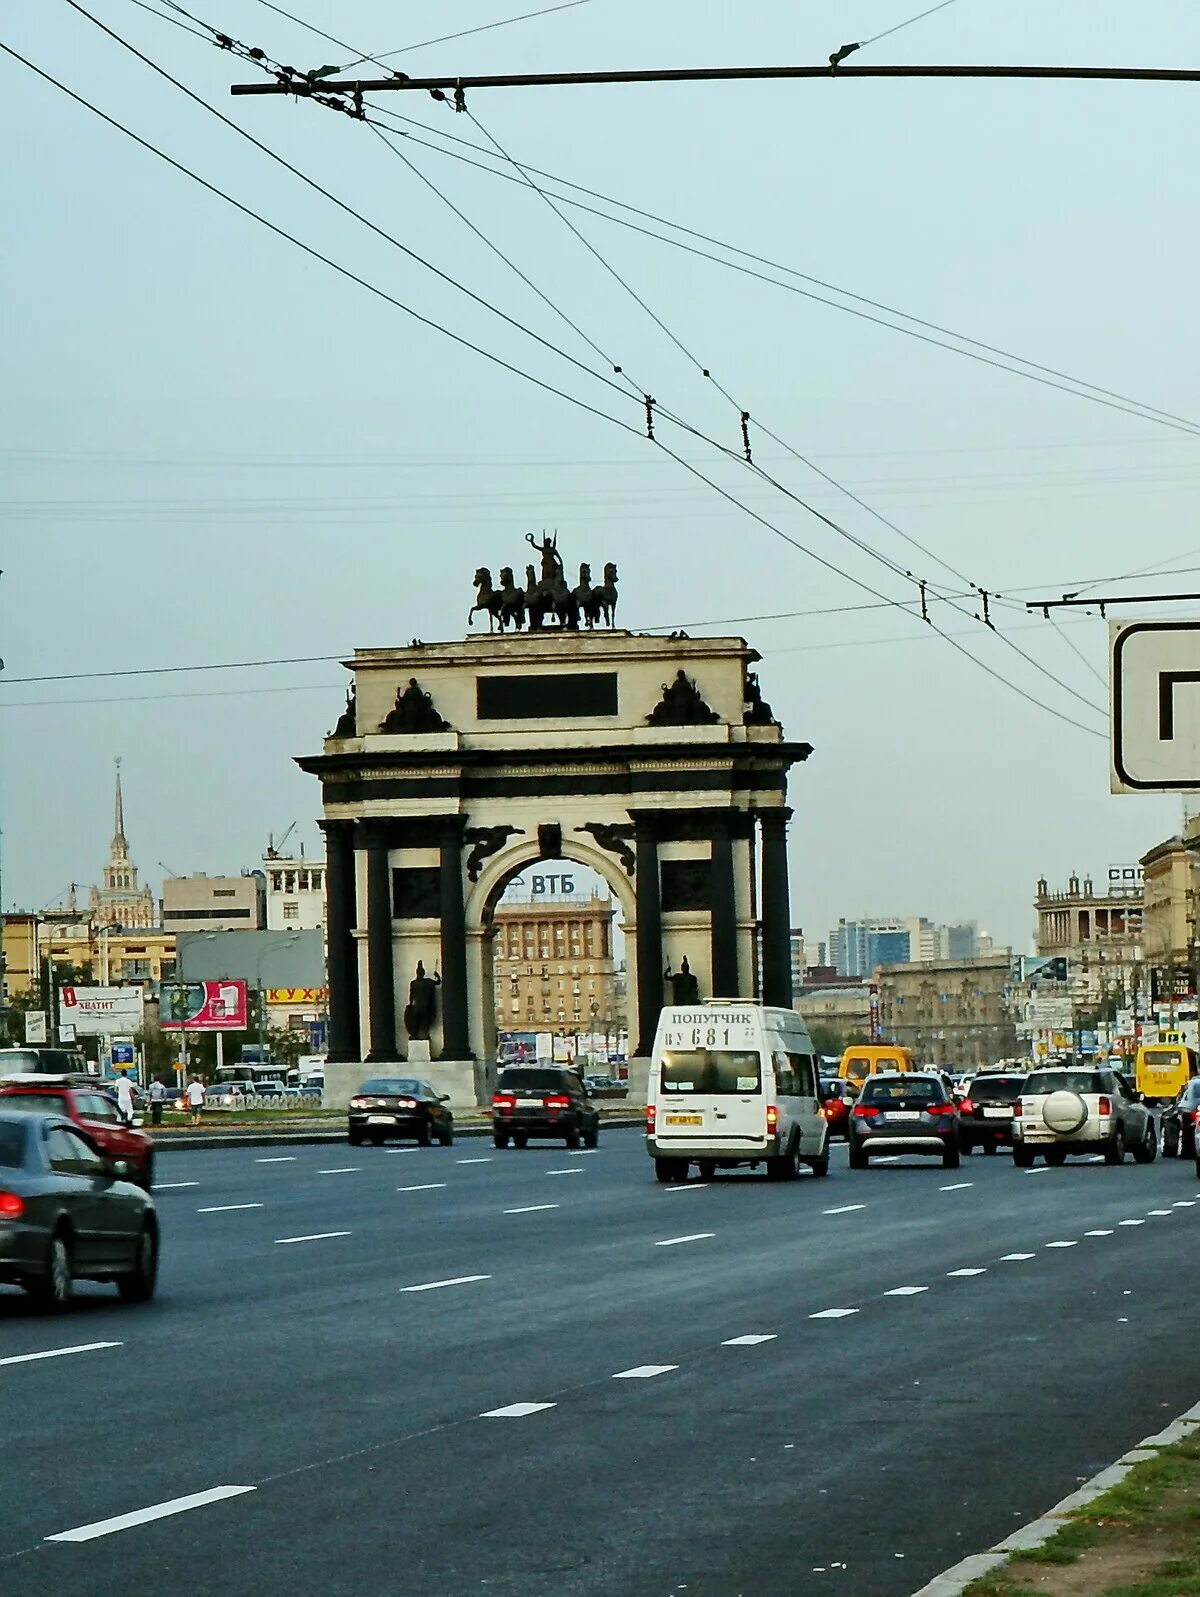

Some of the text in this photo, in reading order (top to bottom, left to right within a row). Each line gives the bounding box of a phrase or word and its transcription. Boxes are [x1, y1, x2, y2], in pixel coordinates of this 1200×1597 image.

[532, 874, 574, 894] ВТБ
[672, 1014, 751, 1024] ПОПУТЧИК
[691, 1028, 729, 1046] 681
